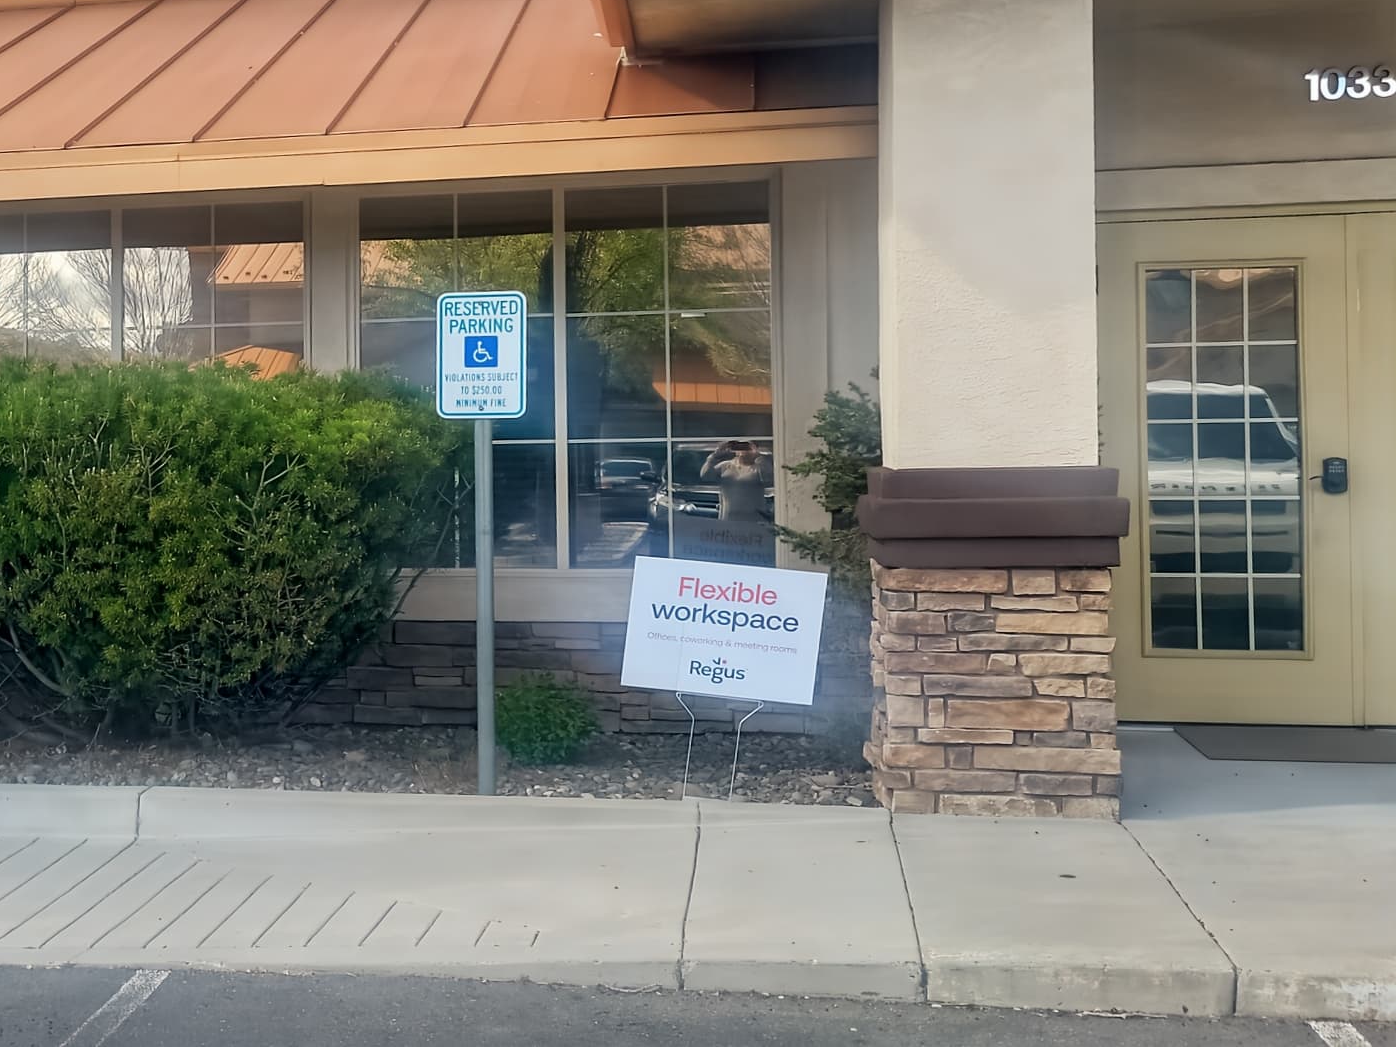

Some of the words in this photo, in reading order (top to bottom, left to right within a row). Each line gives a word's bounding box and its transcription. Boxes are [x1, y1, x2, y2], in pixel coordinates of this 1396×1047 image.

[1304, 66, 1396, 101] 1033
[444, 300, 519, 317] RESERVED
[449, 318, 514, 334] PARKING
[445, 373, 485, 383] VIOLATIONS
[487, 372, 518, 382] SUBJECT
[461, 385, 469, 395] TO
[472, 385, 502, 396] $250.00
[456, 398, 488, 408] MINIMUM
[490, 398, 507, 407] FINE
[678, 576, 778, 606] Flexible
[651, 603, 799, 633] workspace
[679, 634, 724, 648] coworking
[724, 639, 733, 648] &
[734, 641, 769, 653] meeting
[769, 643, 798, 654] rooms
[689, 658, 746, 684] Regus
